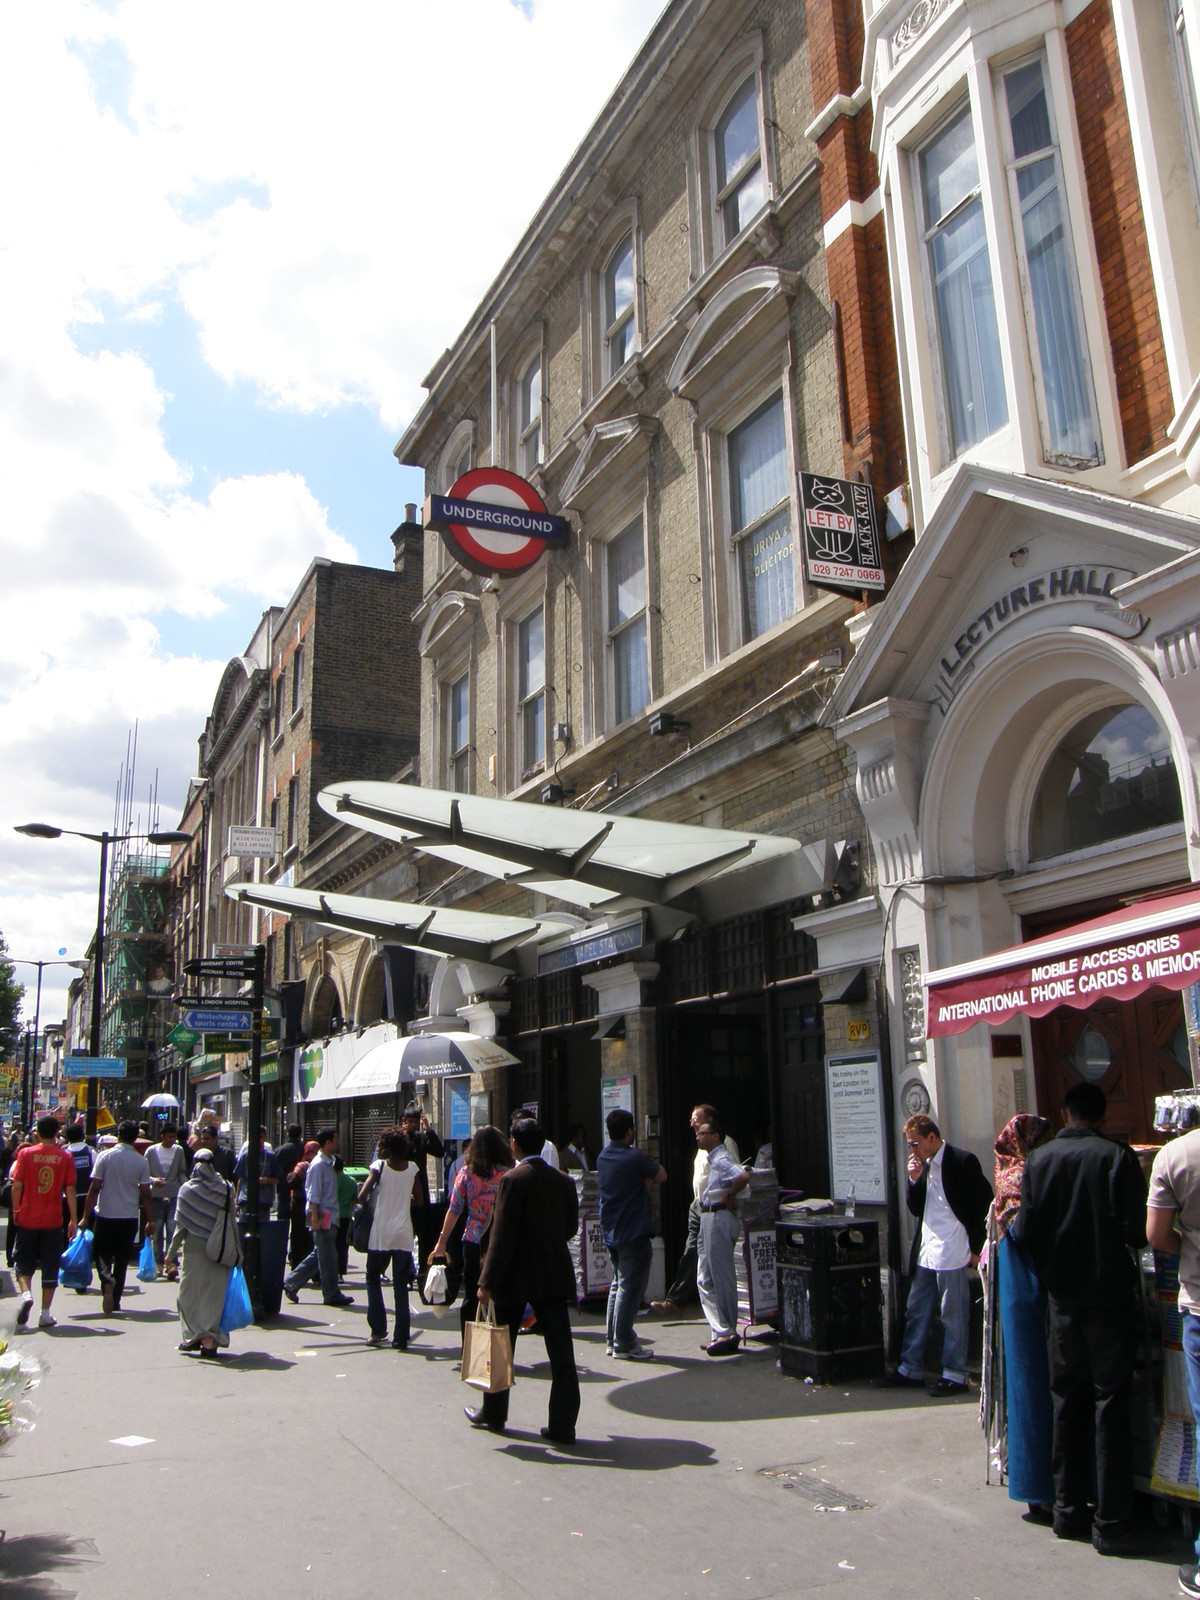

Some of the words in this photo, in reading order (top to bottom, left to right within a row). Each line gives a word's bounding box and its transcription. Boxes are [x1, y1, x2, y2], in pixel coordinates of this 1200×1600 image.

[443, 503, 553, 533] UNDERGROUND
[807, 510, 833, 527] LET
[836, 515, 853, 532] BY
[853, 484, 875, 567] BLACK-KATZ
[813, 563, 831, 575] 020
[833, 565, 854, 578] 7247
[857, 569, 881, 581] 0066
[941, 578, 1045, 677] LECTURE
[1049, 568, 1119, 600] HALL
[546, 943, 598, 968] WHITECHAPEL
[599, 931, 635, 954] STATION
[1031, 958, 1078, 983] MOBILE
[1081, 933, 1181, 971] ACCESSORIES
[938, 993, 1028, 1022] INTERNATIONAL
[1031, 978, 1076, 1003] PHONE
[1078, 965, 1127, 993] CARDS
[1131, 963, 1143, 982] &
[196, 1012, 238, 1021] Whitechapel
[850, 1024, 868, 1037] RVP
[419, 1062, 457, 1071] Evening
[419, 1065, 462, 1076] Standard
[33, 1154, 62, 1164] ROONEY
[38, 1166, 54, 1194] 9
[754, 1248, 777, 1259] FREE
